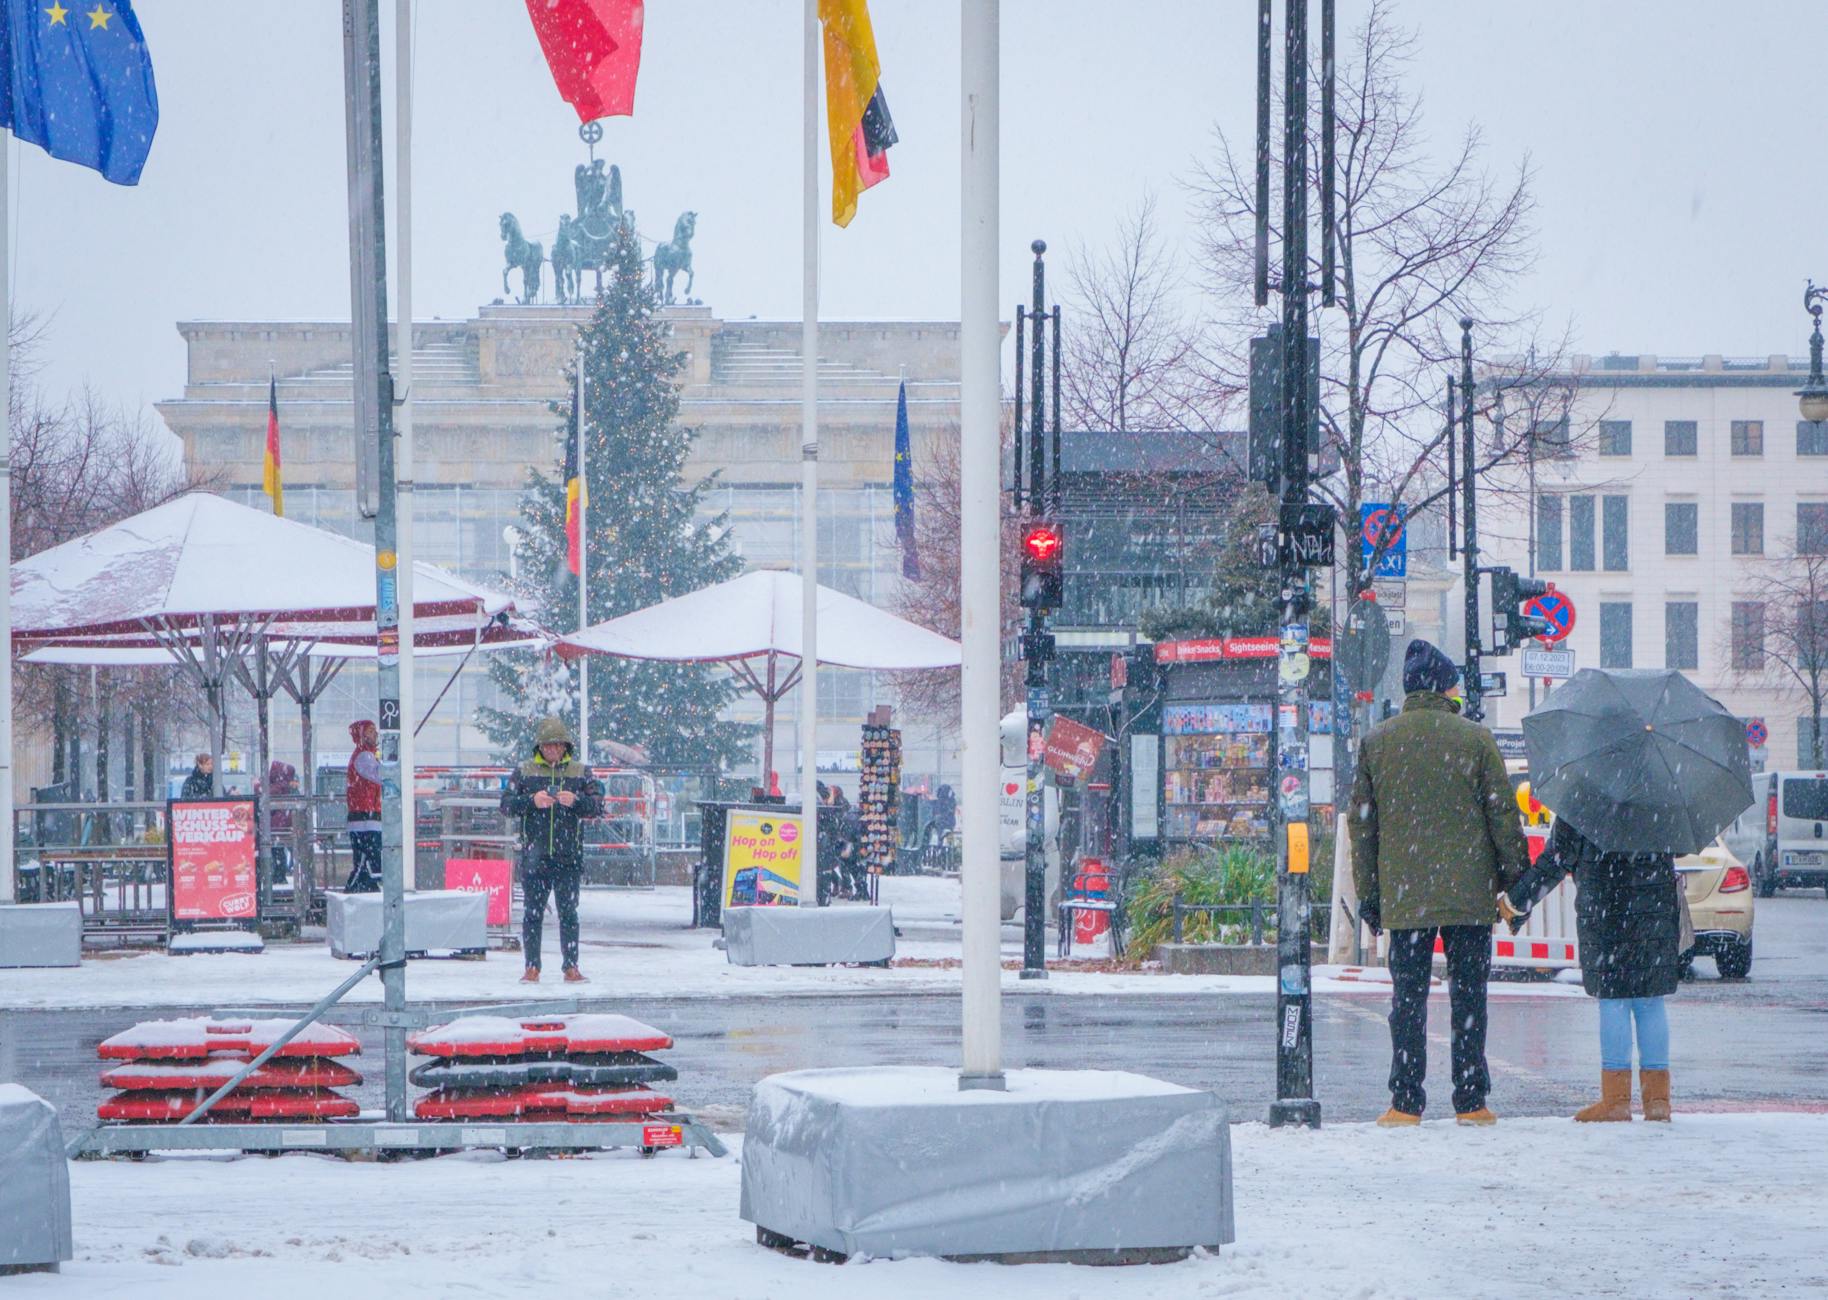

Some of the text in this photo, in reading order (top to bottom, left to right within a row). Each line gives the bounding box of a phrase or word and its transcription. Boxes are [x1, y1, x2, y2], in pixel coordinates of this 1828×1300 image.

[1229, 642, 1280, 655] Sightseeing
[175, 831, 244, 842] VERKAUF
[732, 836, 775, 848] Hop on
[752, 848, 798, 861] Hop off
